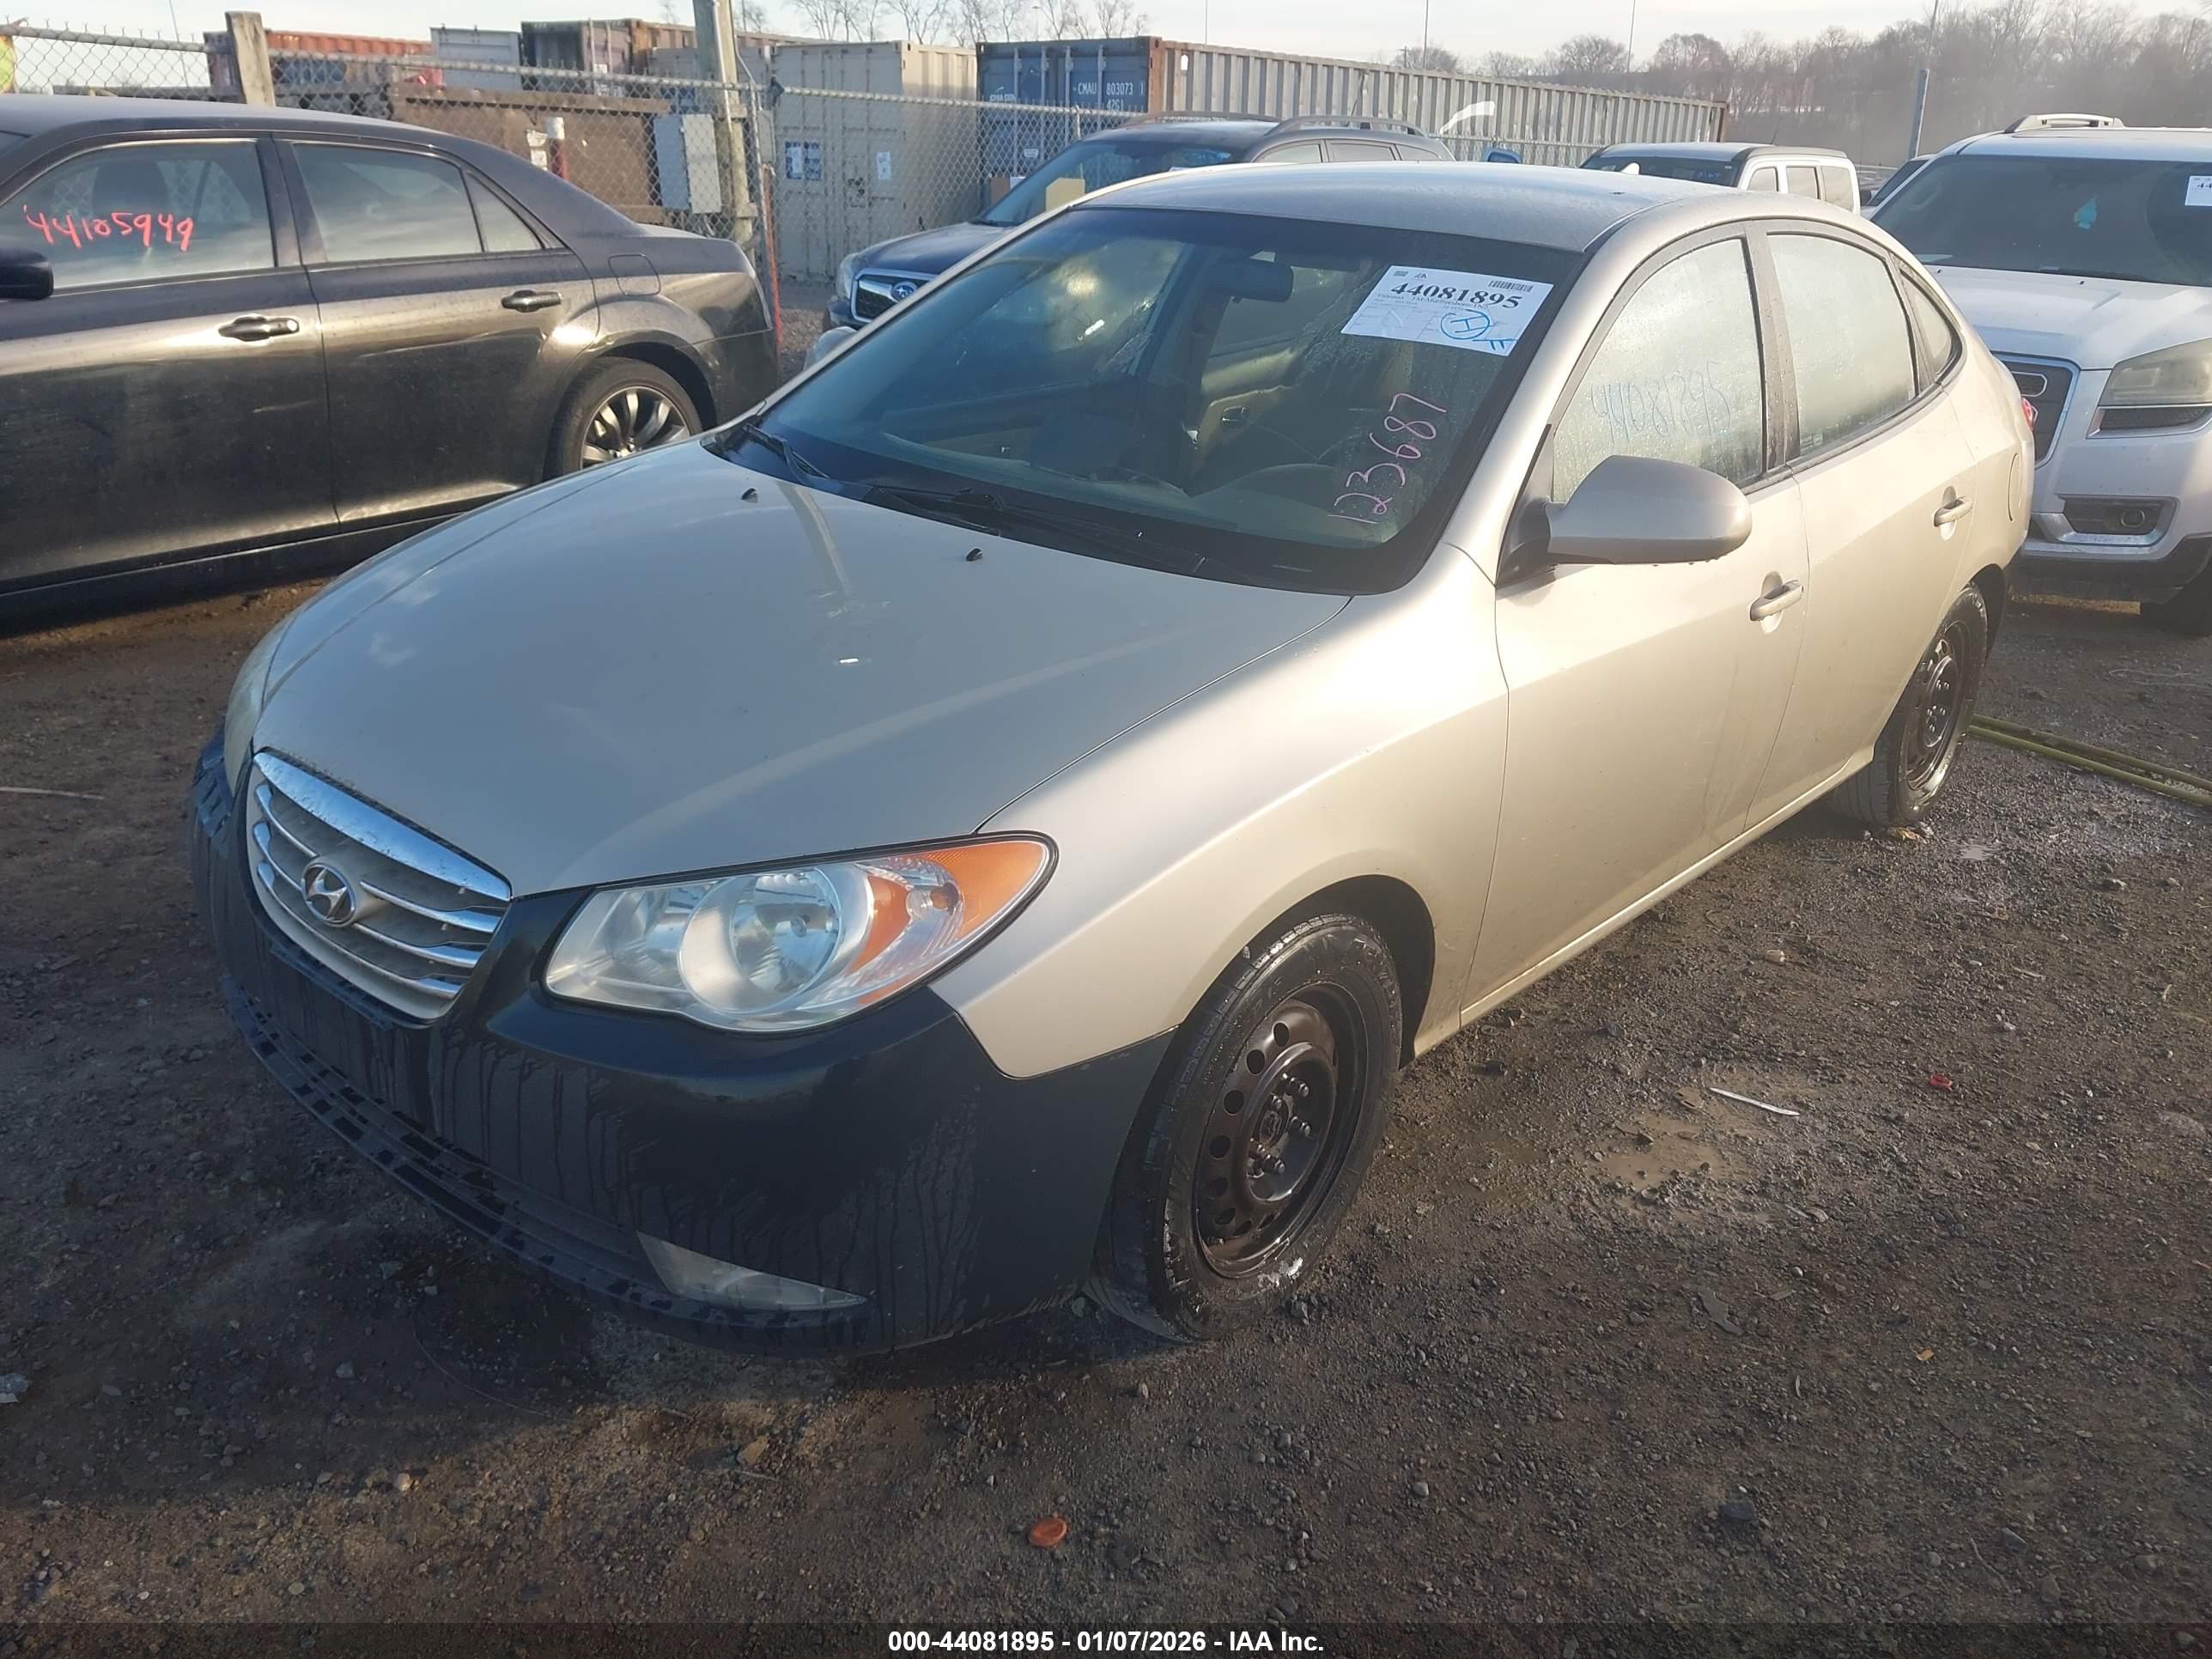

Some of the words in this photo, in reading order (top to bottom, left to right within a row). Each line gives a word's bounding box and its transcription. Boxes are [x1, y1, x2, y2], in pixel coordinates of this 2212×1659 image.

[1078, 82, 1097, 95] CMAU
[1106, 82, 1133, 95] 803073
[1390, 282, 1522, 309] 44081895
[1328, 392, 1447, 525] 123687
